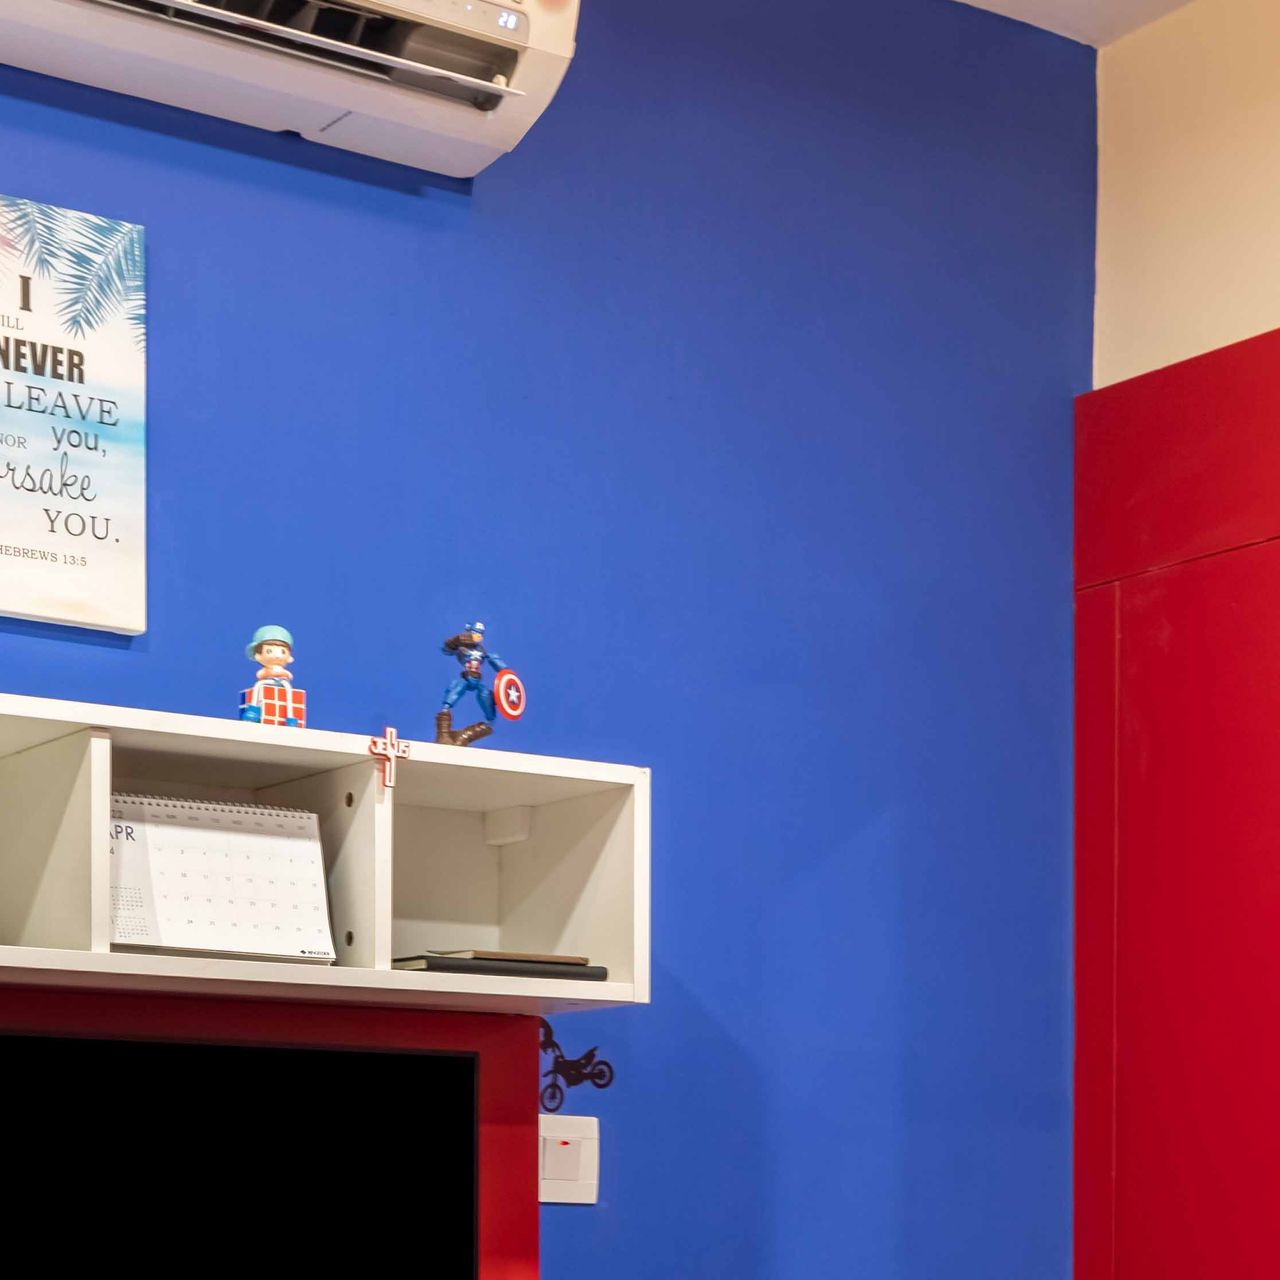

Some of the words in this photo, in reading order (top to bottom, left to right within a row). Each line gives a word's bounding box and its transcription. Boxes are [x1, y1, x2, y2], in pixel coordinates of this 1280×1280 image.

[19, 274, 32, 312] I
[4, 381, 120, 426] LEAVE
[51, 426, 107, 457] you,
[42, 508, 120, 543] YOU.
[63, 554, 87, 567] 13:5
